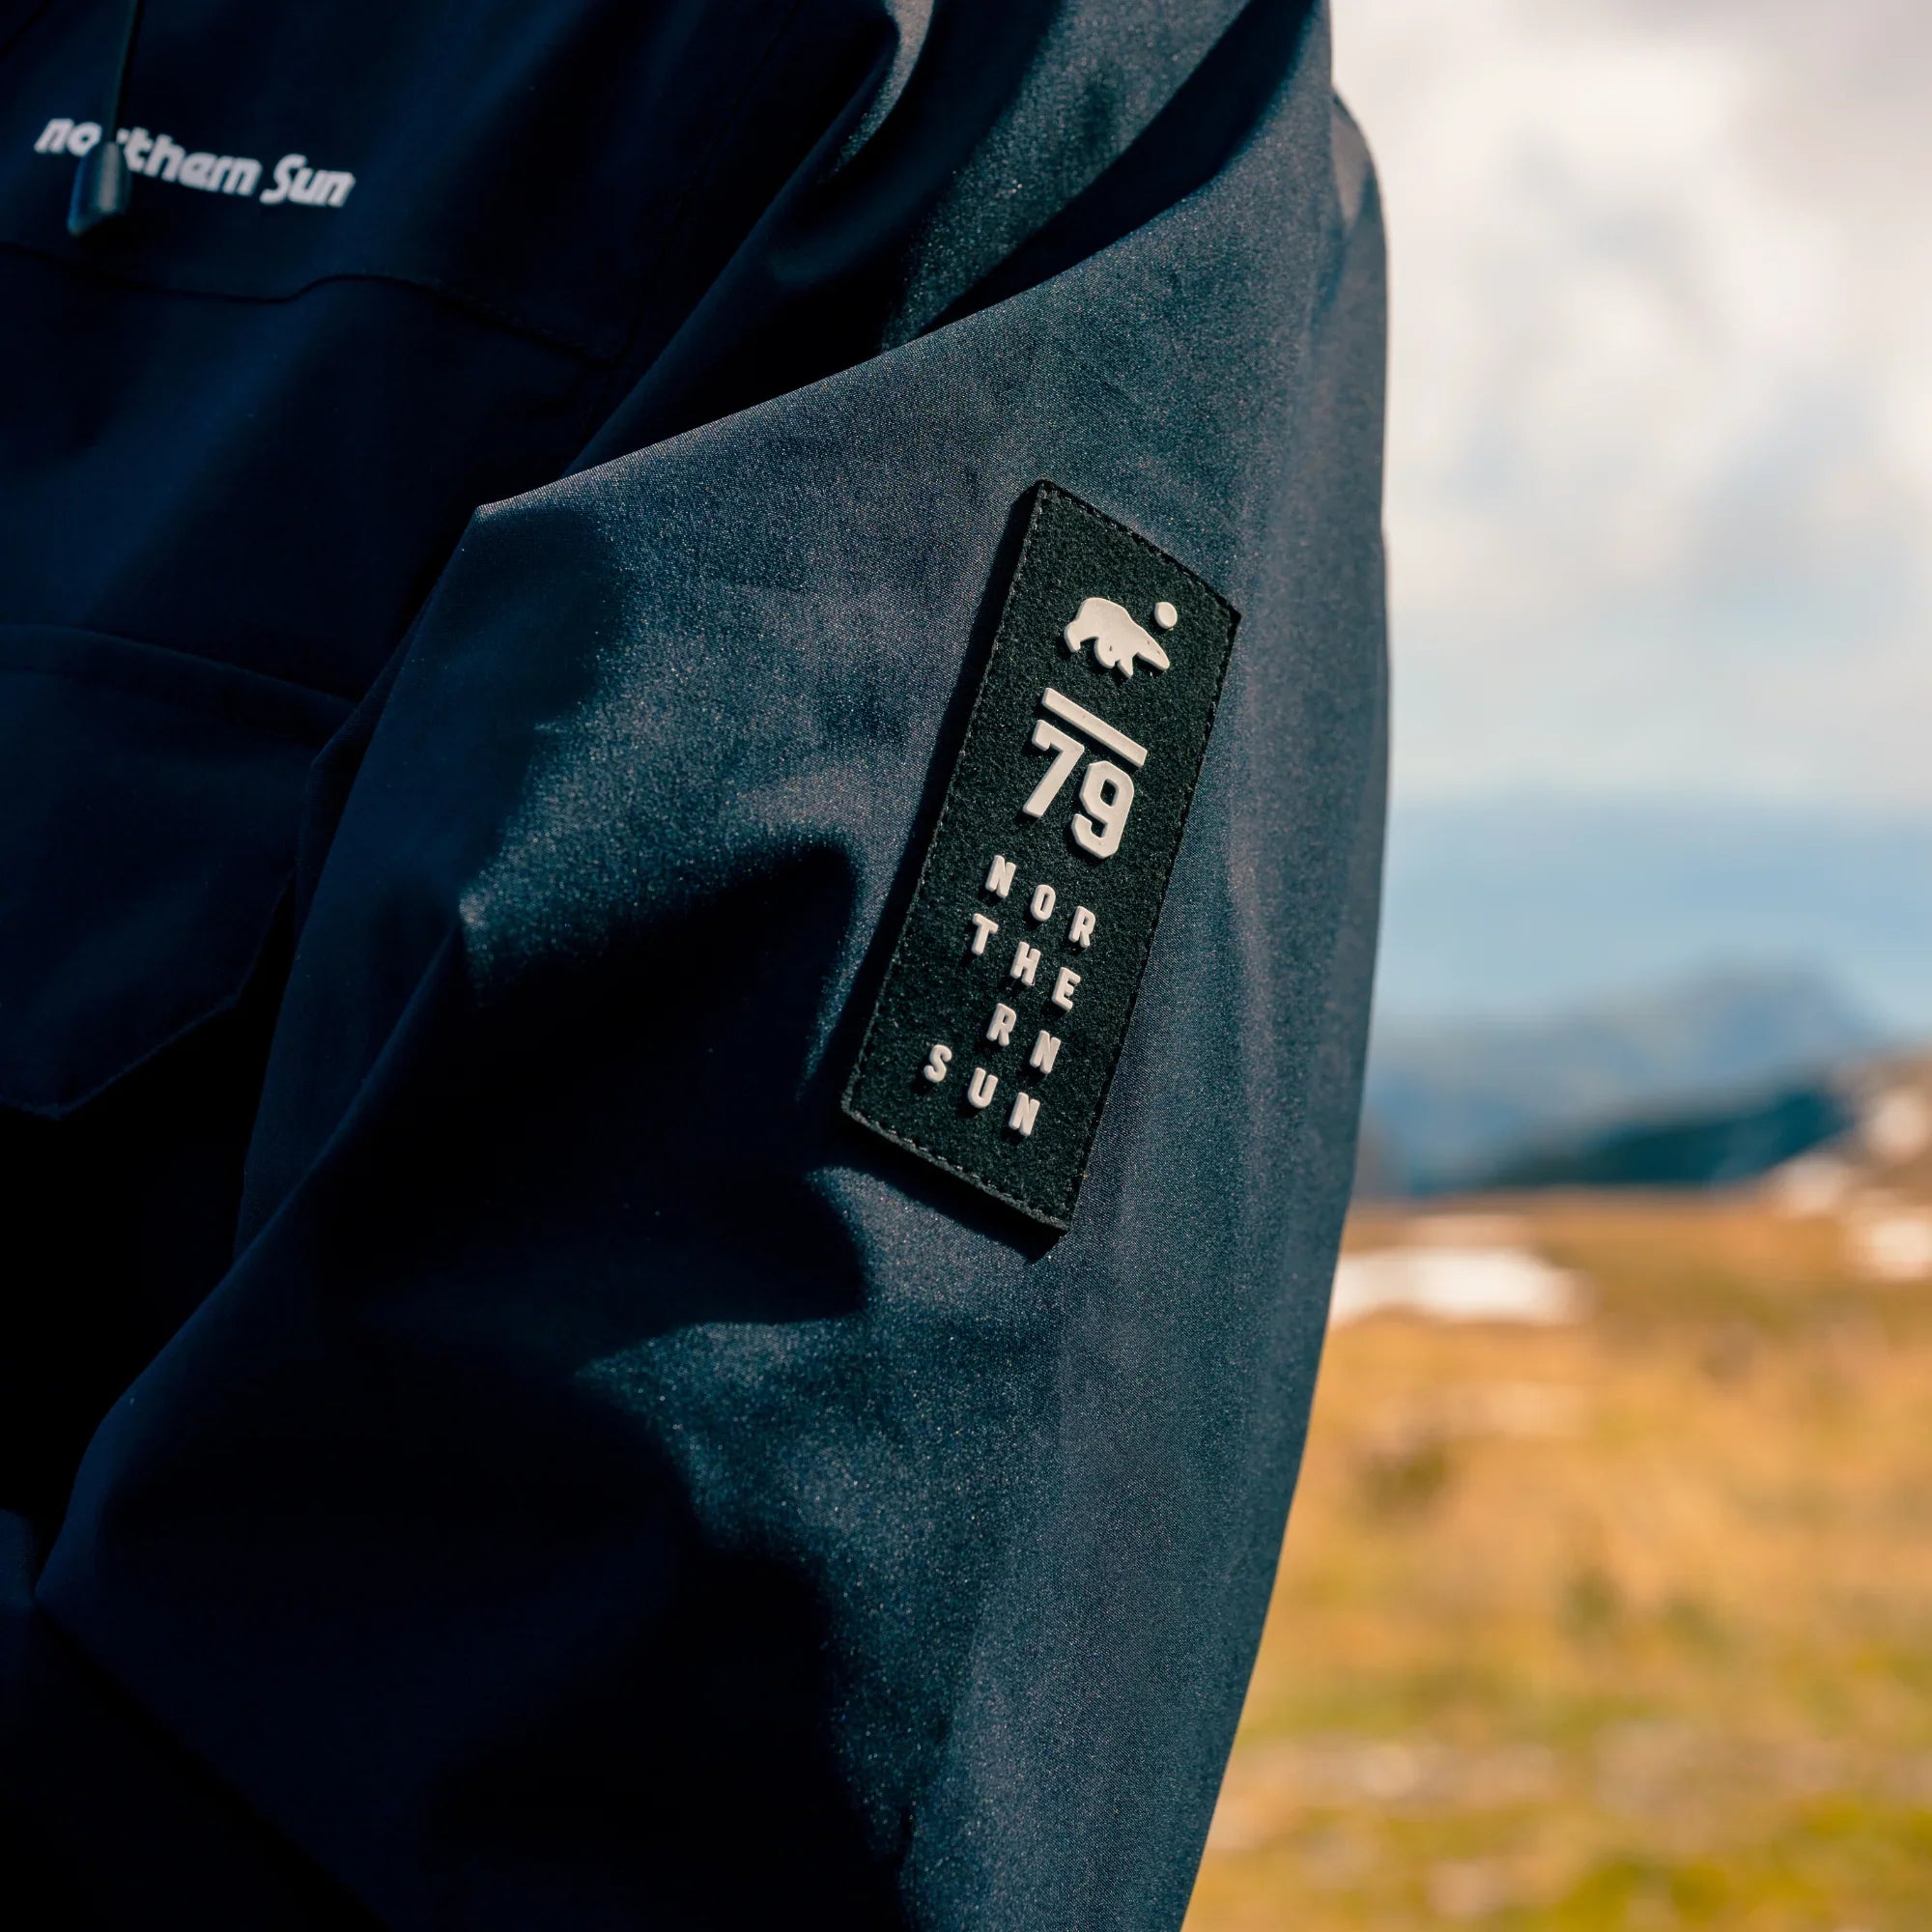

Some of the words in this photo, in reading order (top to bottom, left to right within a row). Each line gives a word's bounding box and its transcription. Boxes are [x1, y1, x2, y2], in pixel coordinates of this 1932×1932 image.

[35, 117, 262, 195] nothern
[260, 154, 355, 207] Sun
[1024, 720, 1135, 859] 79
[985, 854, 1096, 948] NOR
[972, 912, 1082, 1010] THE
[986, 1003, 1062, 1074] RN
[923, 1043, 1041, 1136] SUN
